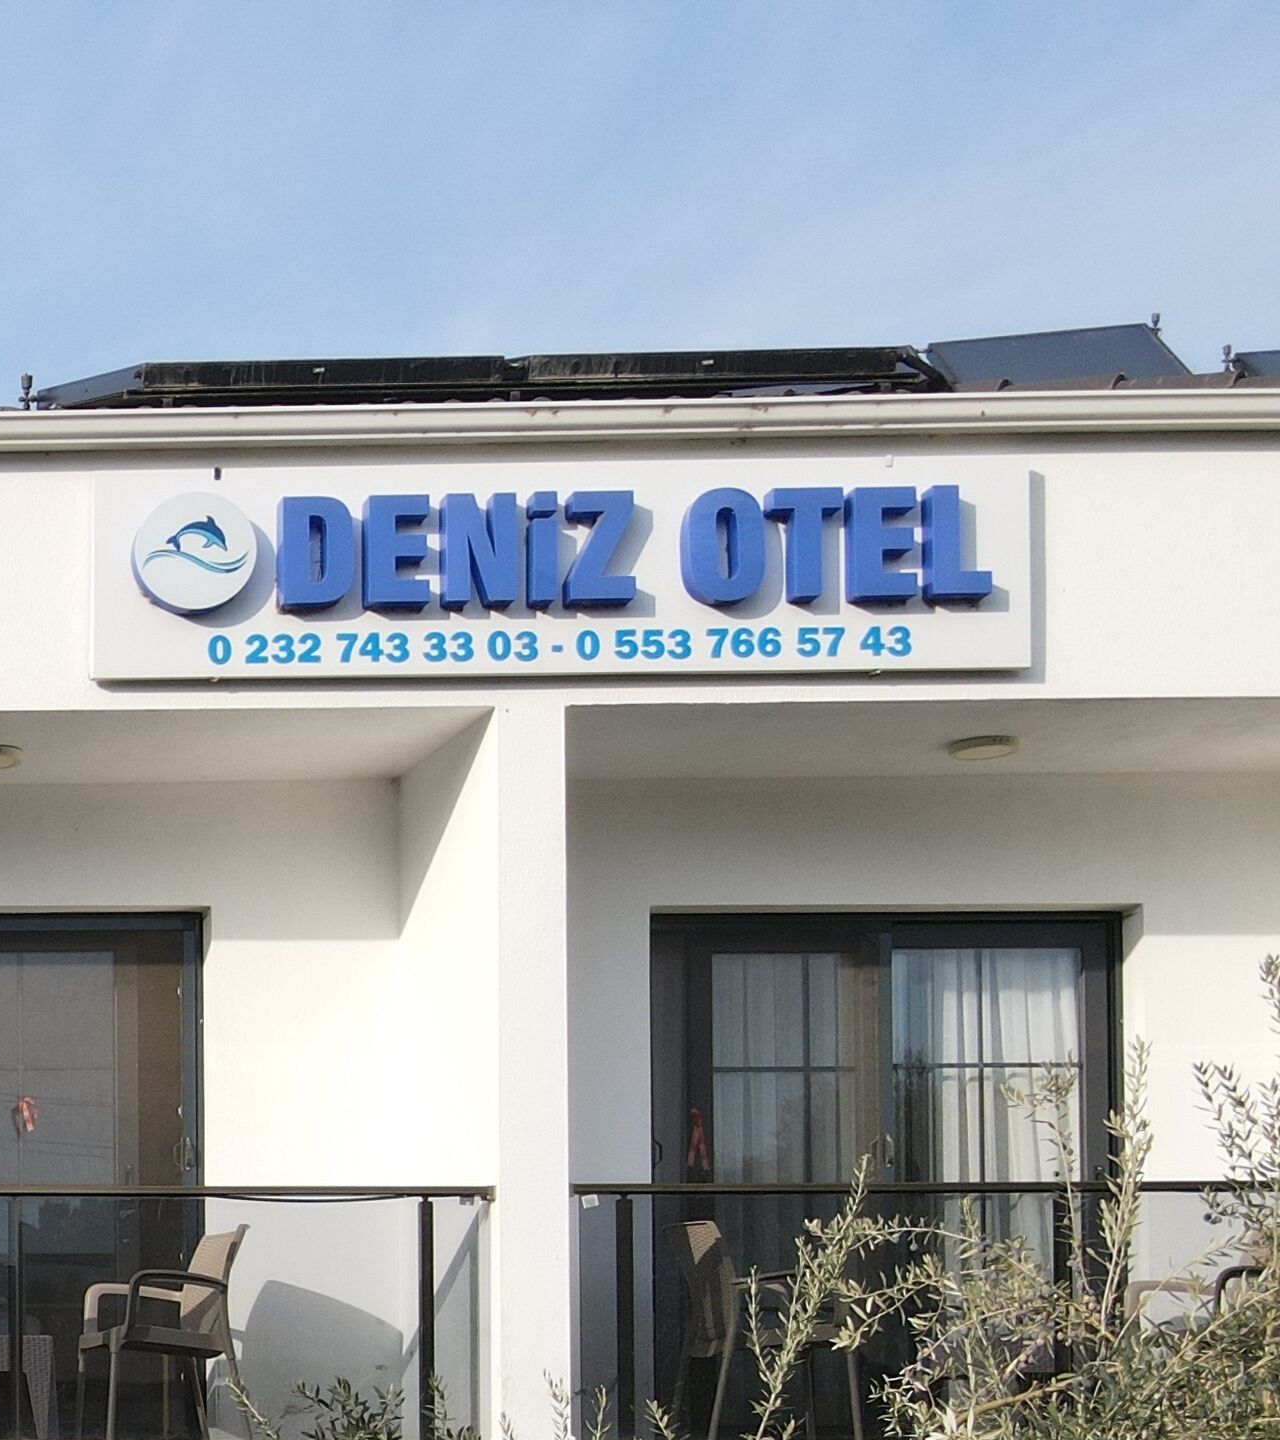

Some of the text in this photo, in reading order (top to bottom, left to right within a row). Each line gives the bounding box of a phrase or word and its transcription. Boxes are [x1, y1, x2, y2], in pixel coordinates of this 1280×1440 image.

[680, 484, 994, 608] OTEL
[207, 634, 233, 666] 0
[245, 632, 322, 665] 232
[336, 631, 411, 663] 743
[424, 631, 475, 663] 33
[487, 630, 540, 662] 03
[576, 629, 602, 661] 0
[614, 628, 693, 660] 553
[706, 627, 783, 659] 766
[797, 626, 846, 658] 57
[860, 625, 913, 657] 43
